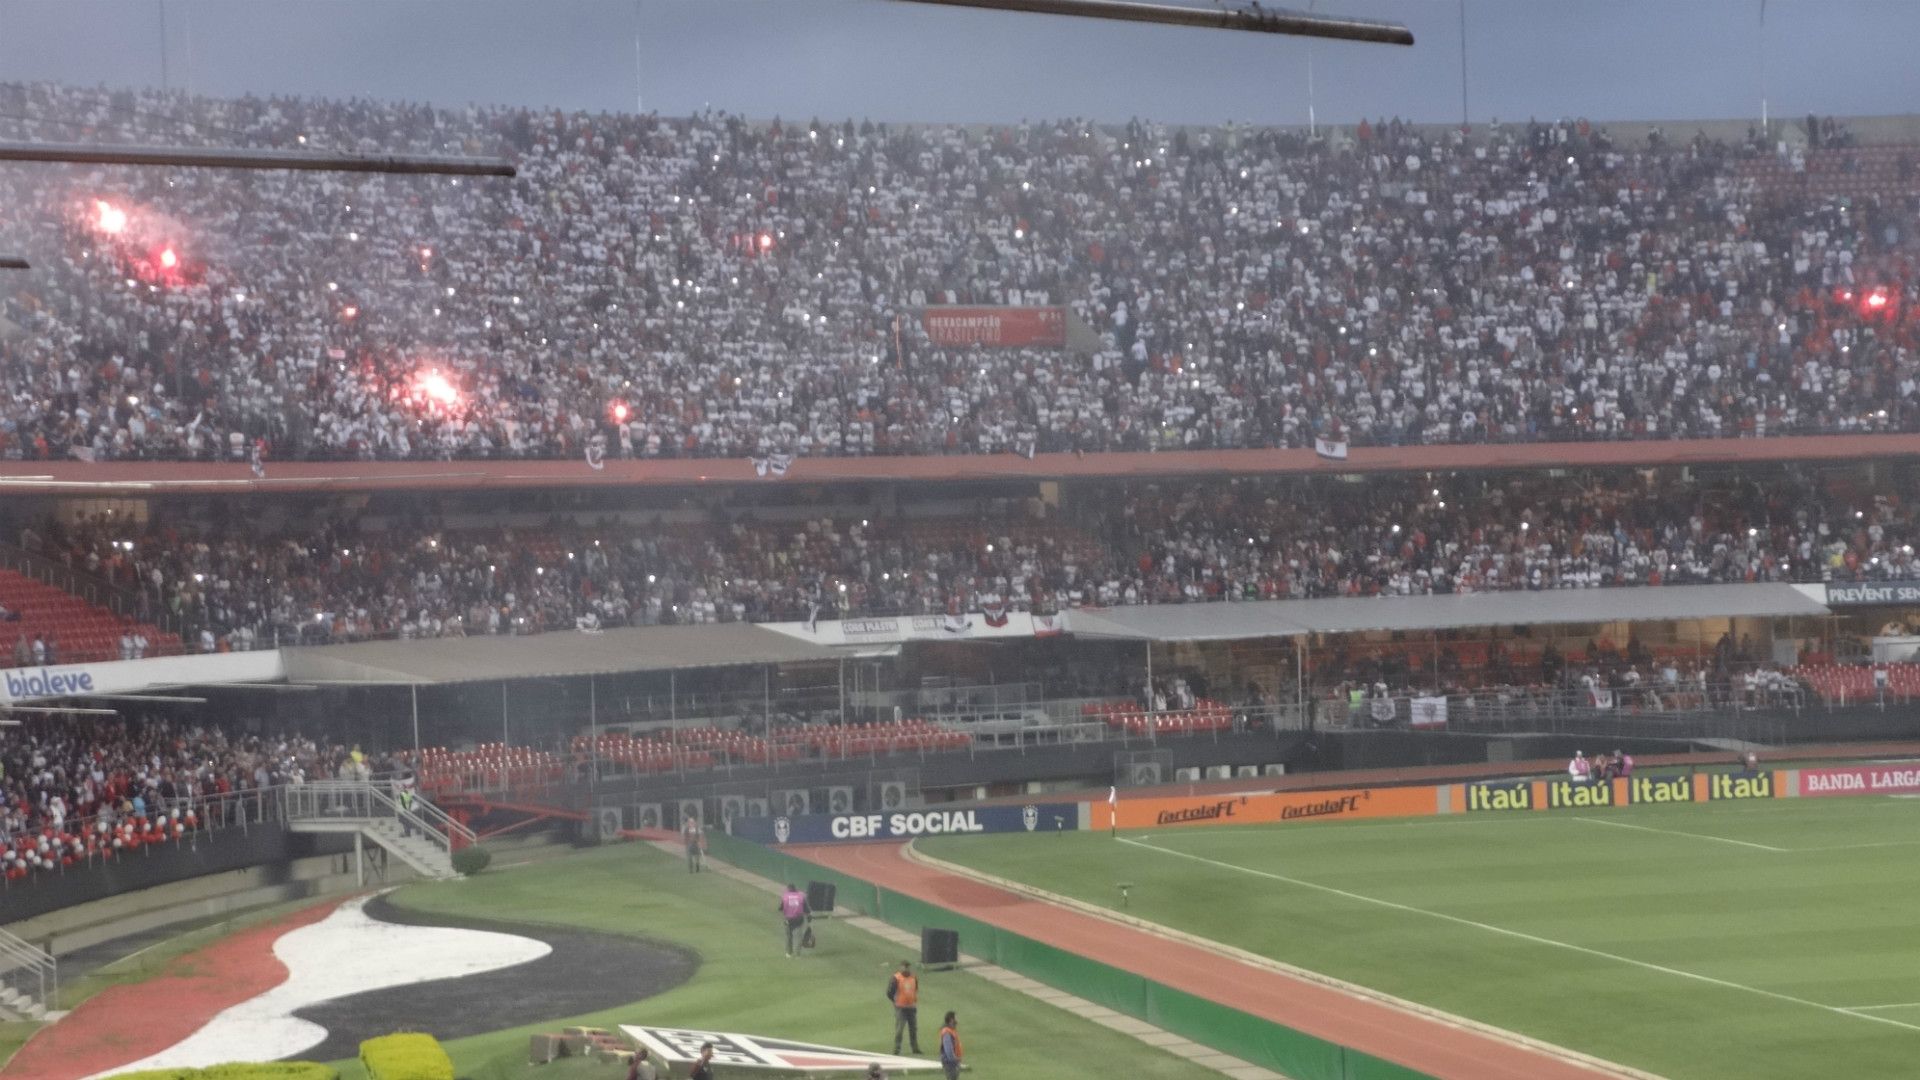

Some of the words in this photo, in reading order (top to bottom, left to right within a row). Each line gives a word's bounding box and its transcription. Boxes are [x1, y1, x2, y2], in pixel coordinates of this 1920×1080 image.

[1828, 583, 1893, 602] PREVENT
[5, 668, 94, 699] bioleve
[1551, 779, 1610, 807] Itaú
[1632, 776, 1690, 804] Itaú
[1711, 772, 1770, 799] Itaú
[1807, 773, 1865, 792] BANDA
[1470, 783, 1529, 811] Itaú
[831, 814, 882, 839] CBF
[890, 810, 983, 835] SOCIAL
